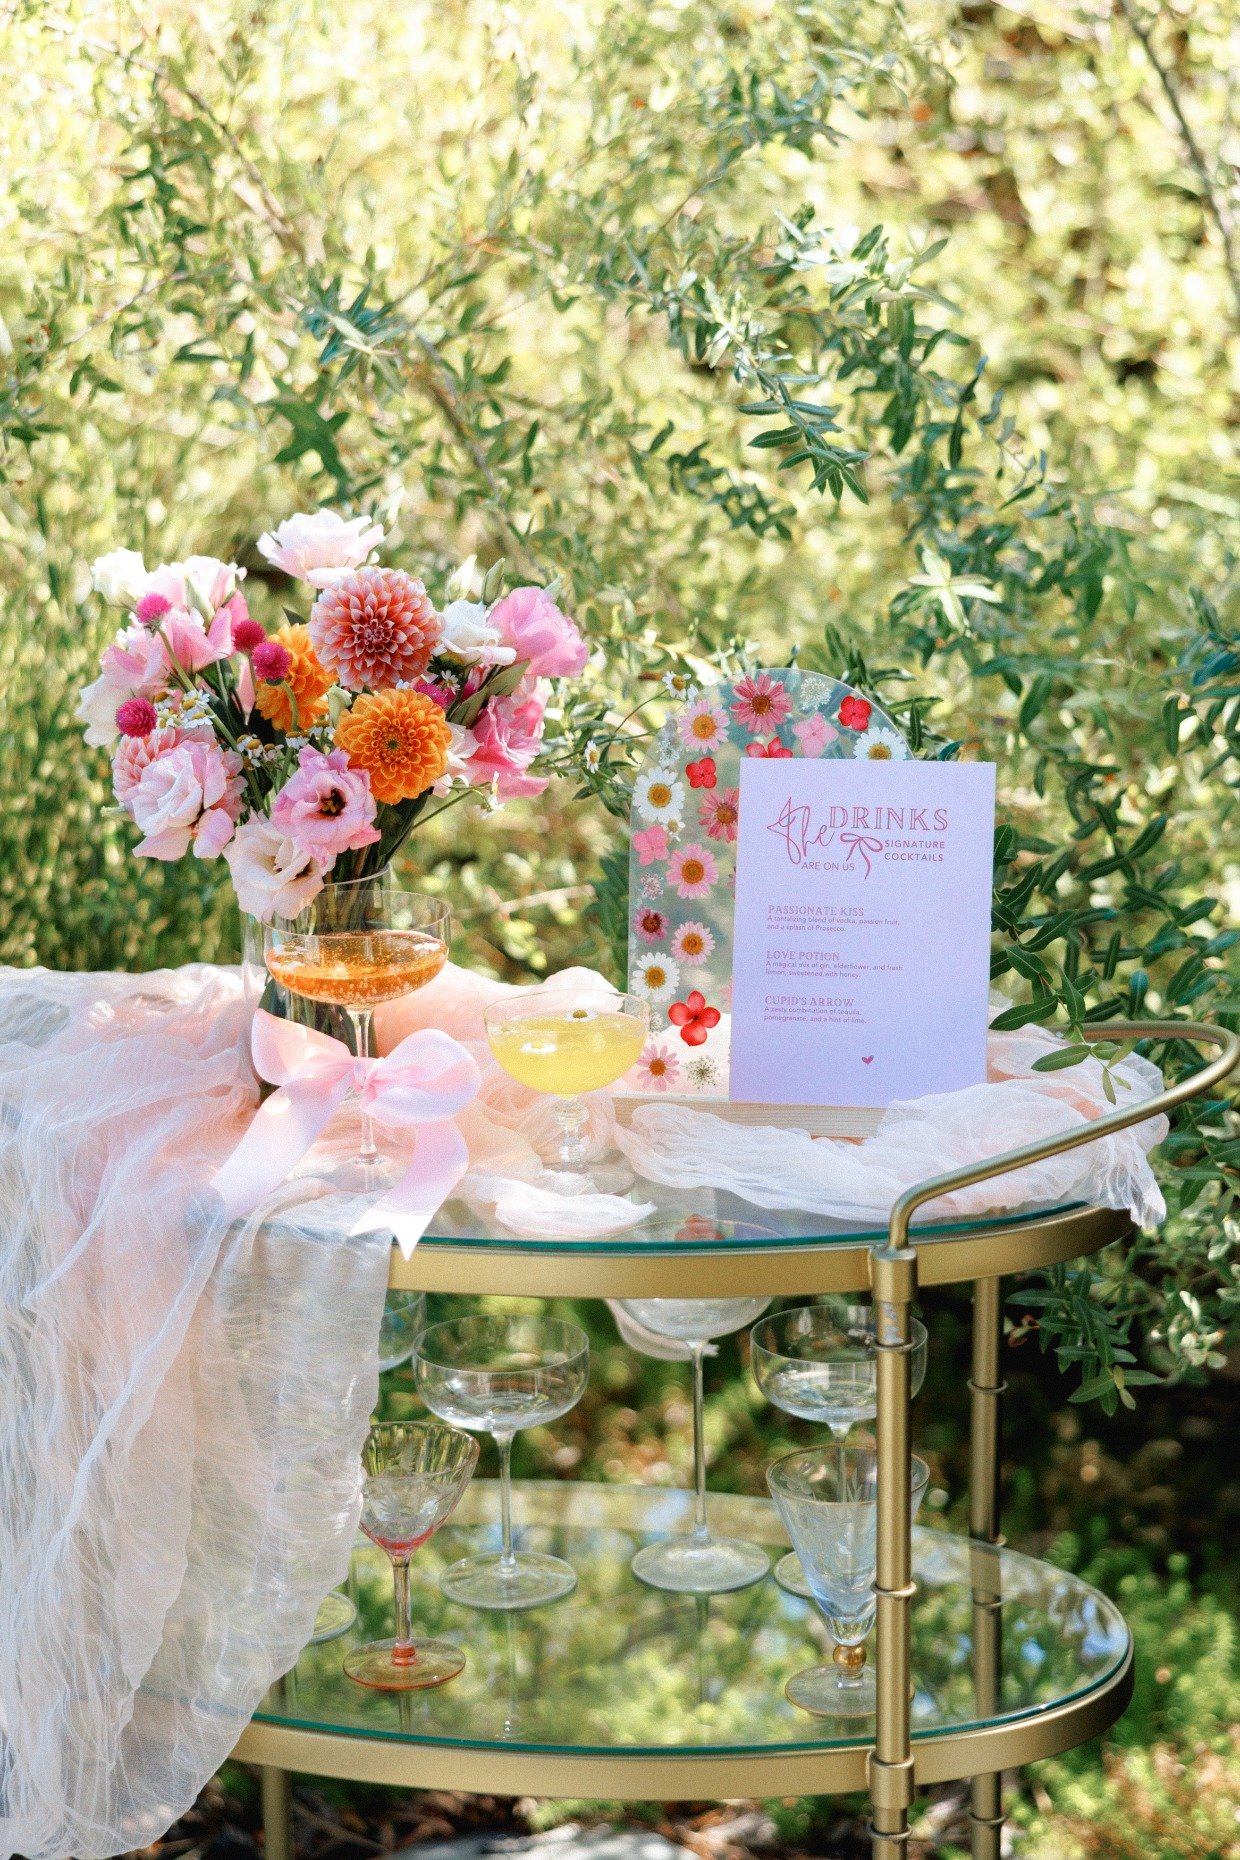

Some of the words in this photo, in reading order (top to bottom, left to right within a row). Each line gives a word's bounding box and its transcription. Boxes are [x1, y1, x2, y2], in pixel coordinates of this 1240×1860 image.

[767, 797, 835, 865] The
[829, 805, 949, 831] DRINKS
[884, 839, 945, 849] SIGNATURE
[884, 852, 944, 862] COCKTAILS
[801, 861, 821, 870] ARE
[823, 862, 839, 871] ON
[842, 862, 855, 872] US
[768, 905, 837, 916] PASSIONATE
[840, 907, 864, 917] KISS
[774, 916, 807, 924] tantalizing
[767, 950, 796, 960] LOVE
[799, 951, 840, 961] POTION
[772, 961, 797, 969] magical
[833, 963, 871, 971] elderflower,
[840, 971, 861, 979] honey.
[765, 995, 807, 1005] CUPID'S
[810, 997, 855, 1007] ARROW
[838, 1009, 861, 1017] tequila,
[764, 1015, 808, 1023] pomegranate,
